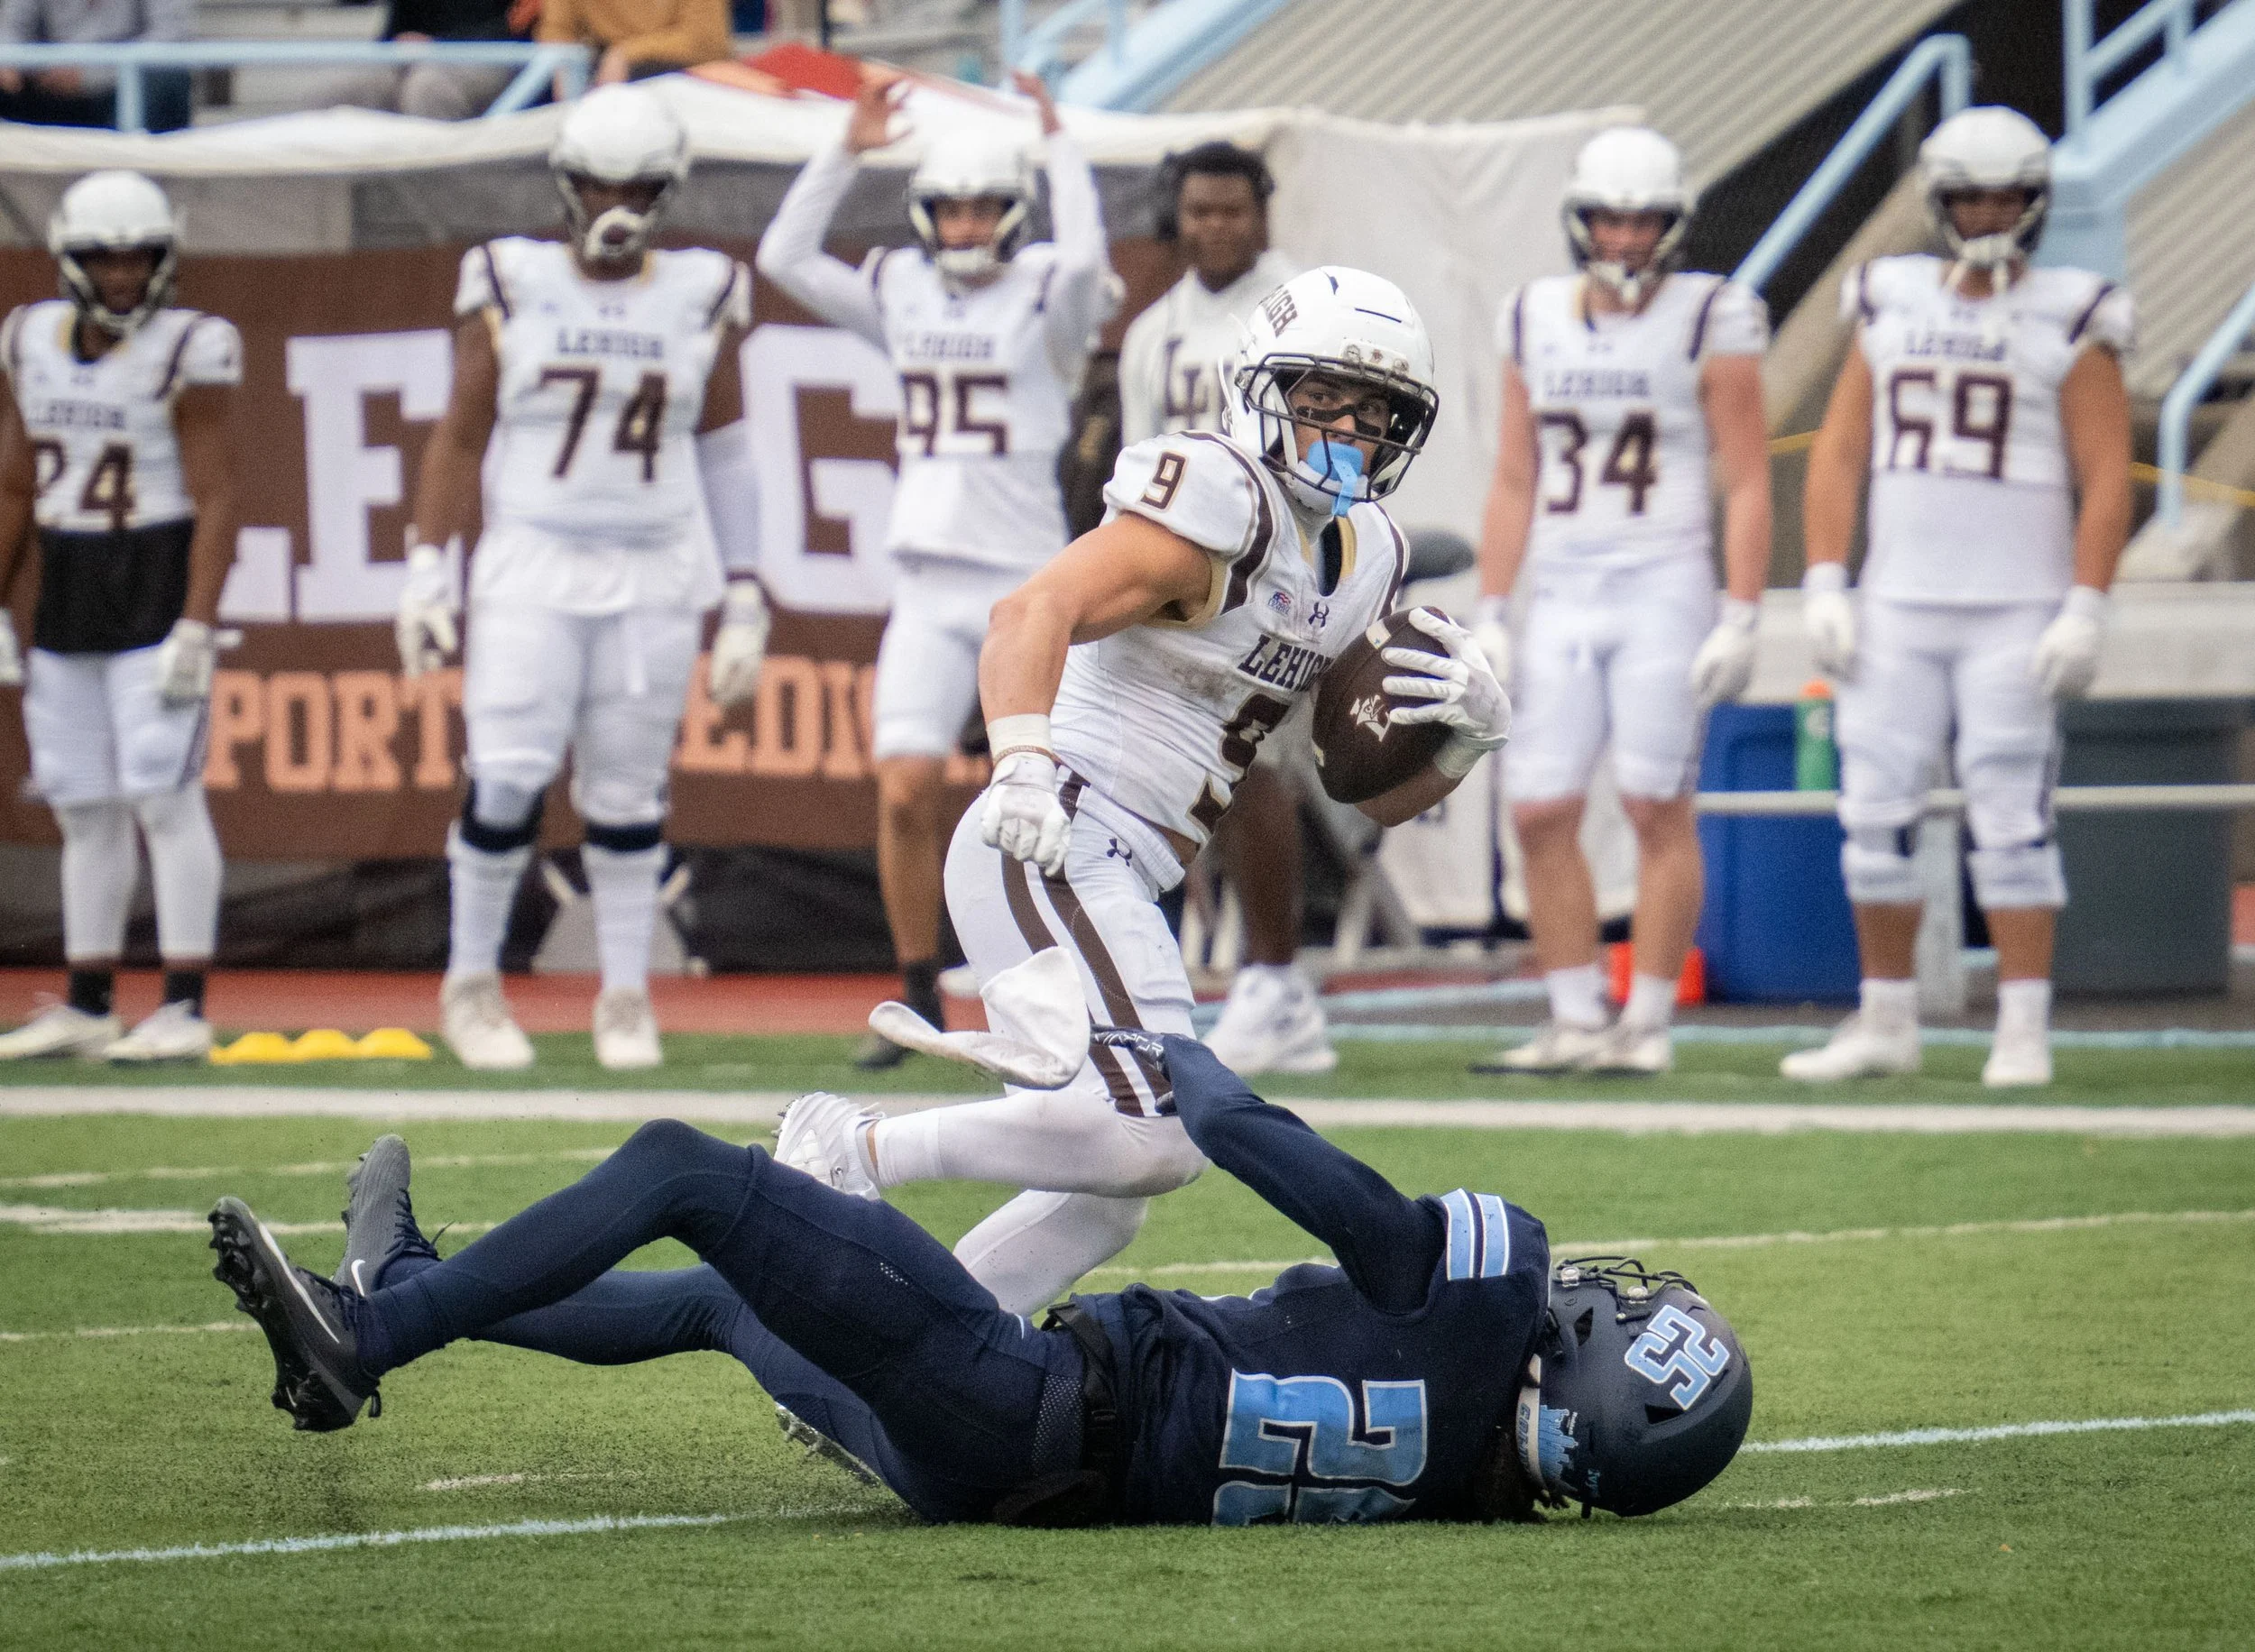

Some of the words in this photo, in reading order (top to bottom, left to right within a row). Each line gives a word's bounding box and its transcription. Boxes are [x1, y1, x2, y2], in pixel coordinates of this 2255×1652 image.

[541, 369, 667, 483] 74
[901, 374, 1006, 456] 95
[1537, 411, 1657, 514] 34
[1889, 371, 2011, 480] 69
[1139, 450, 1187, 511] 9
[1237, 633, 1335, 693] LEHIG
[1624, 1304, 1731, 1411] 25
